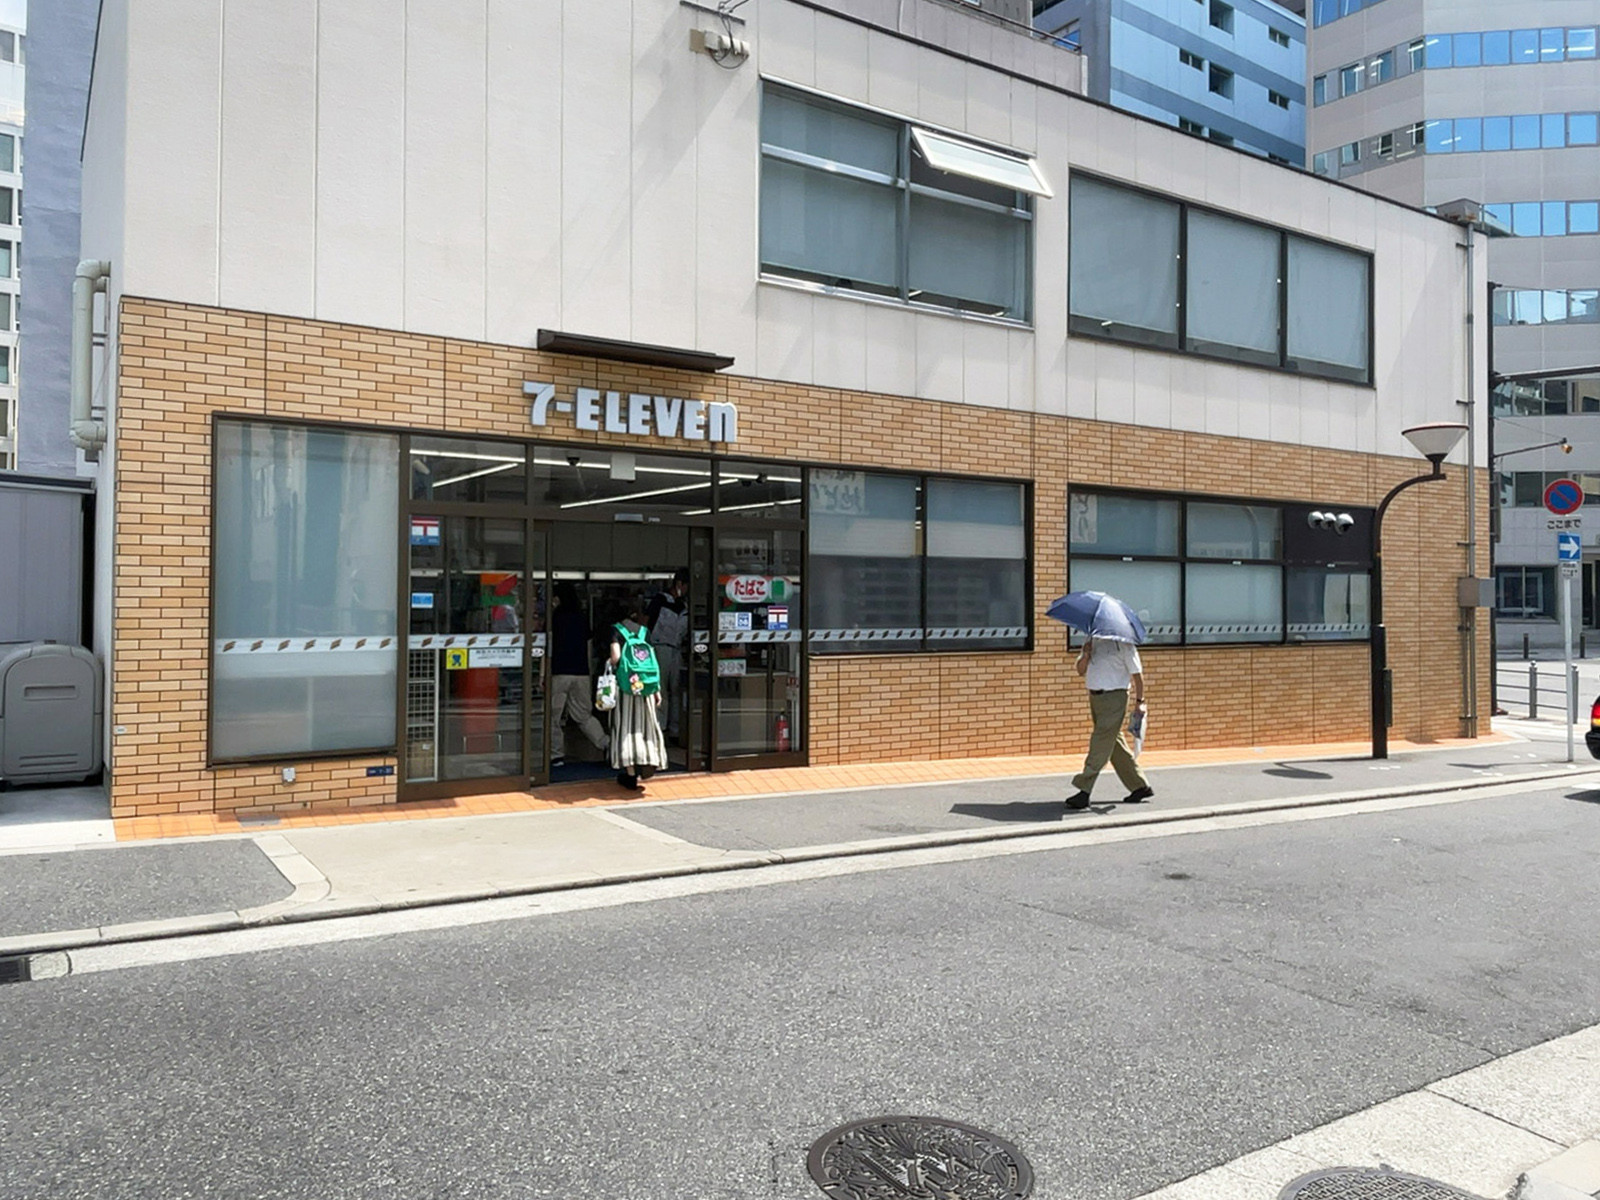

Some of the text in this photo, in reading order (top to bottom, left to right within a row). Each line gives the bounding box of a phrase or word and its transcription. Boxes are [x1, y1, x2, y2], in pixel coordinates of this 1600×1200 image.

[1547, 519, 1582, 529] ここまで
[734, 579, 766, 596] たばこ
